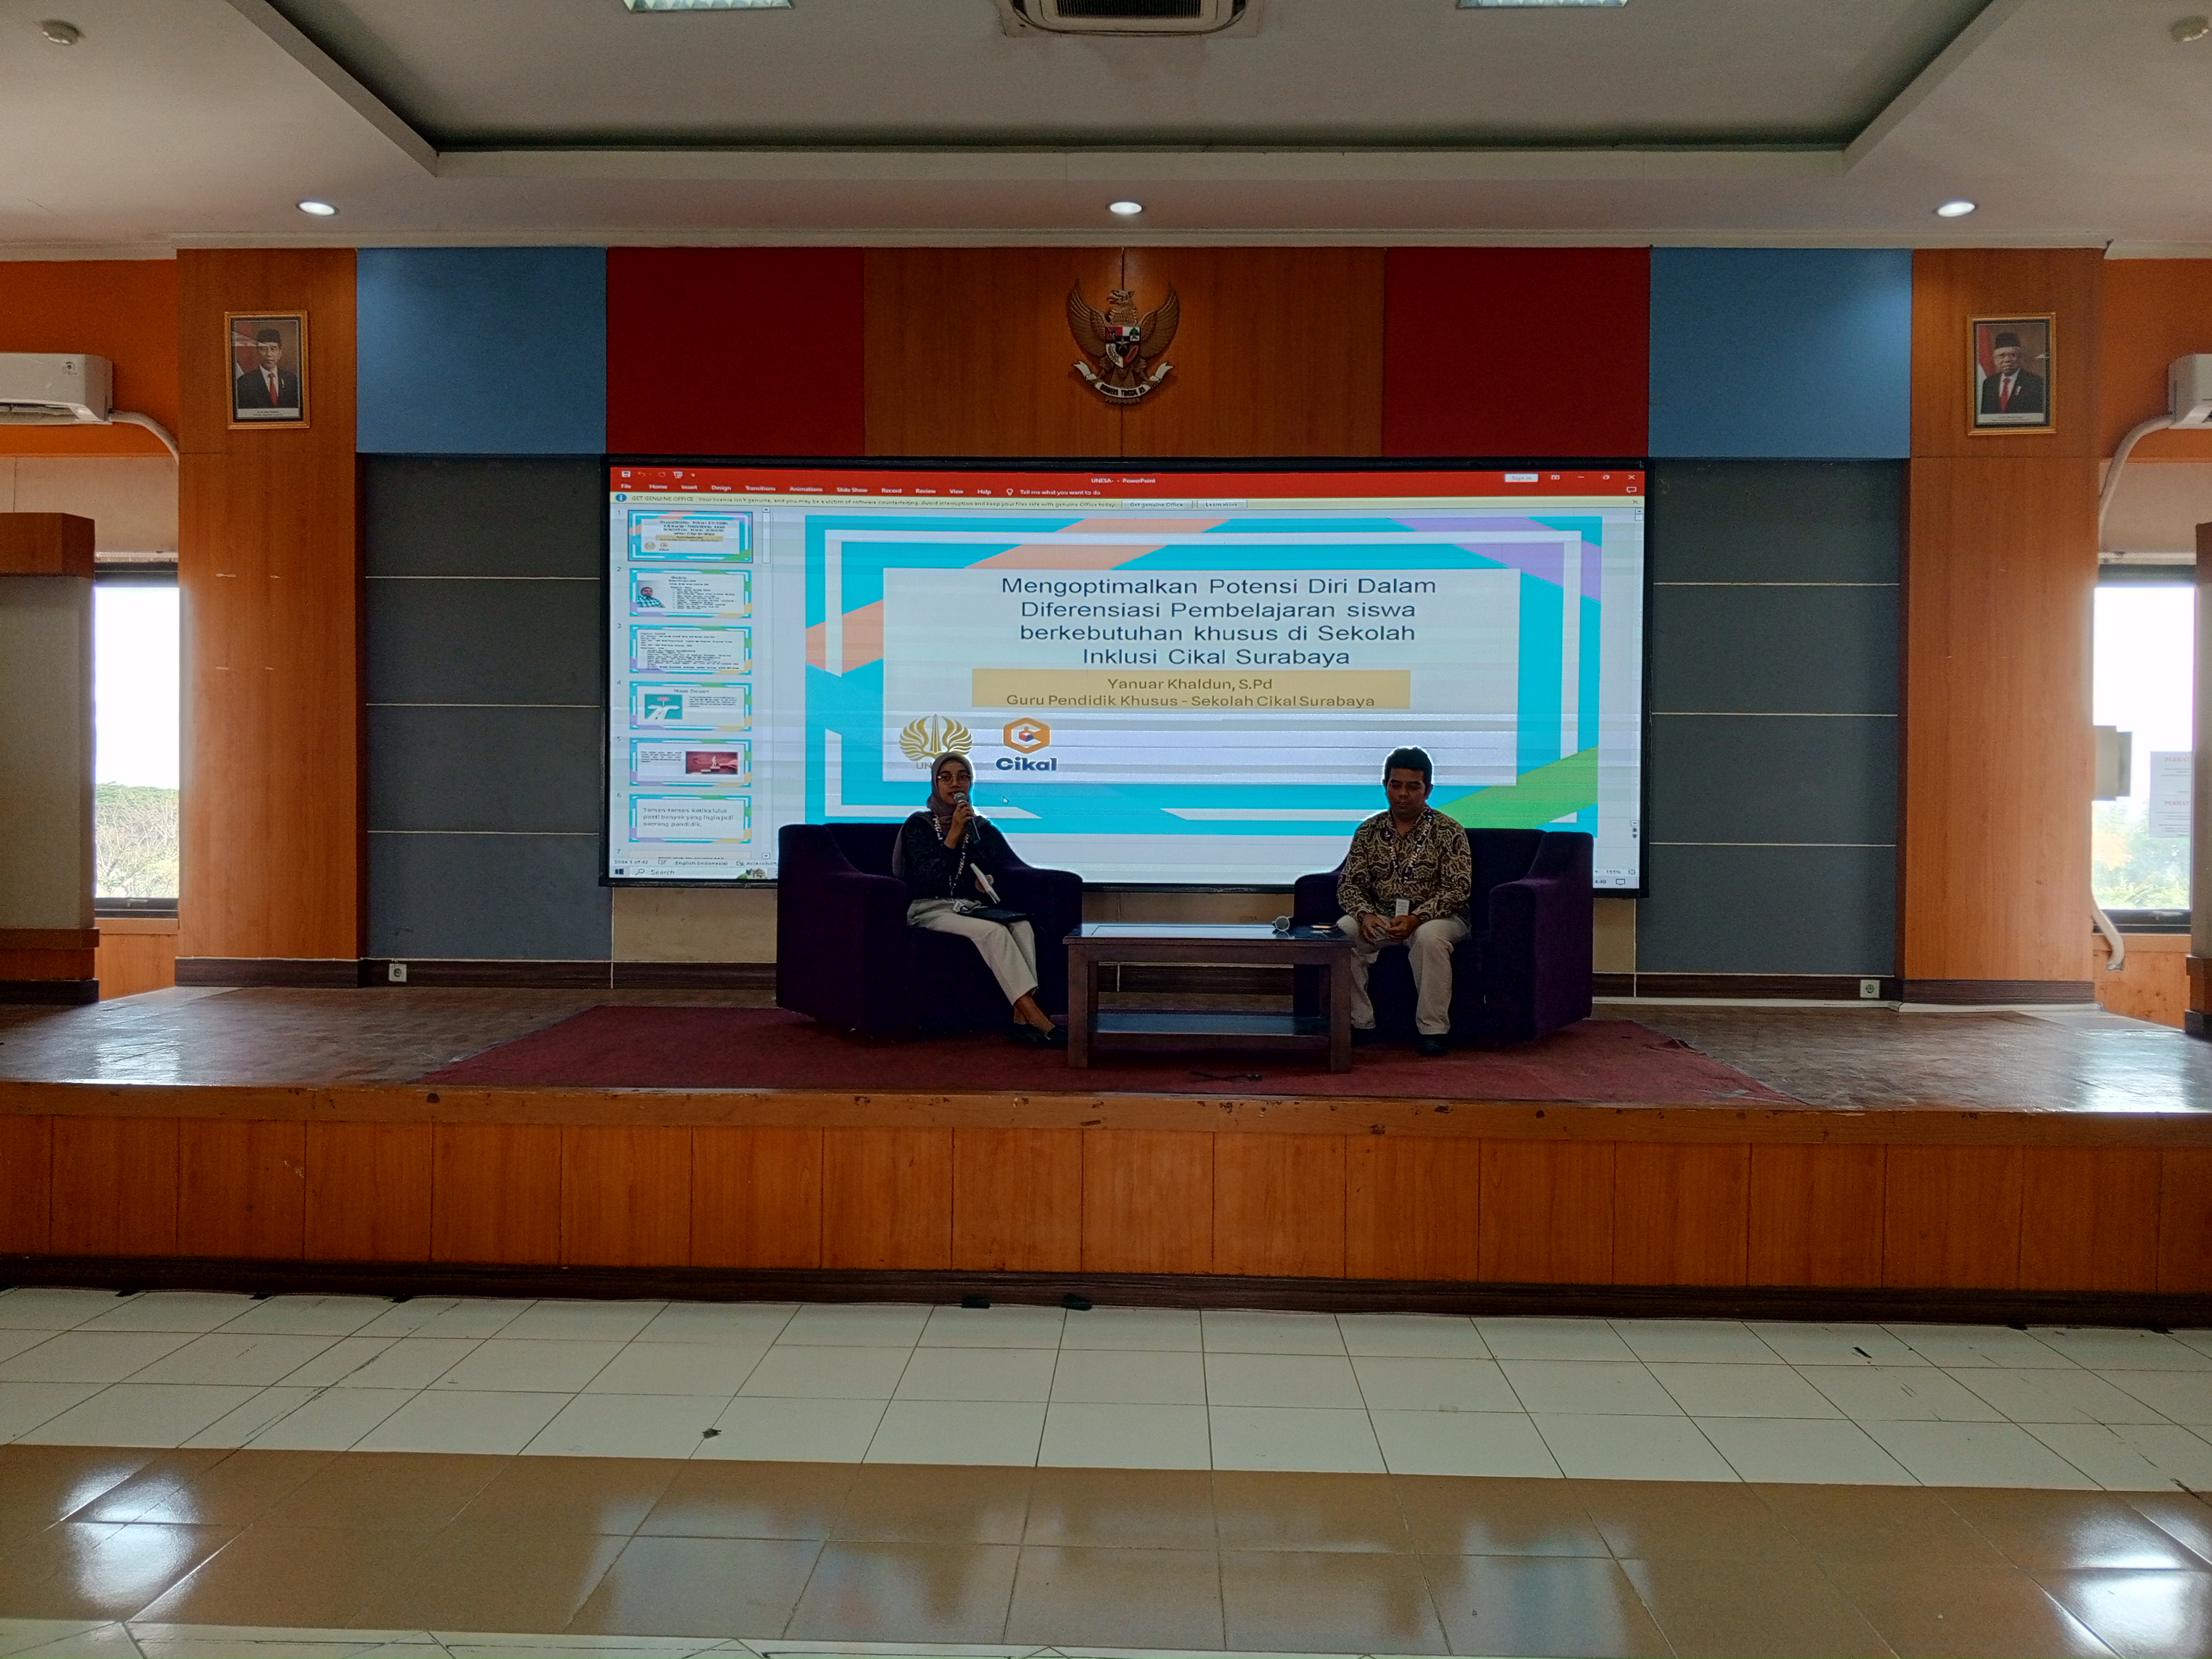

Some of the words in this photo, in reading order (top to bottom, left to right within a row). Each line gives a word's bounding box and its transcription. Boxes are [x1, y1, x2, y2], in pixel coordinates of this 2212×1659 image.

[1002, 577, 1197, 597] Mengoptimalkan
[1210, 579, 1298, 594] Potensi
[1309, 579, 1348, 594] Diri
[1358, 578, 1436, 593] Dalam
[1022, 602, 1160, 617] Diferensiasi
[1171, 603, 1335, 621] Pembelajaran
[1347, 602, 1416, 617] siswa
[1021, 625, 1183, 641] berkebutuhan
[1195, 625, 1278, 641] khusus
[1288, 625, 1307, 641] di
[1318, 625, 1415, 641] Sekolah
[1084, 648, 1157, 664] Inklusi
[1169, 649, 1226, 665] Cikal
[1236, 649, 1350, 668] Surabaya
[1108, 679, 1164, 690] Yanuar
[1168, 678, 1236, 692] Khaldun,
[1238, 678, 1273, 690] S.Pd
[1006, 695, 1044, 705] Guru
[1048, 695, 1117, 706] Pendidik
[1121, 695, 1178, 706] Khusus
[1191, 695, 1254, 707] Sekolah
[1257, 695, 1297, 707] Cikal
[1299, 696, 1375, 709] Surabaya
[996, 757, 1057, 771] Cikal
